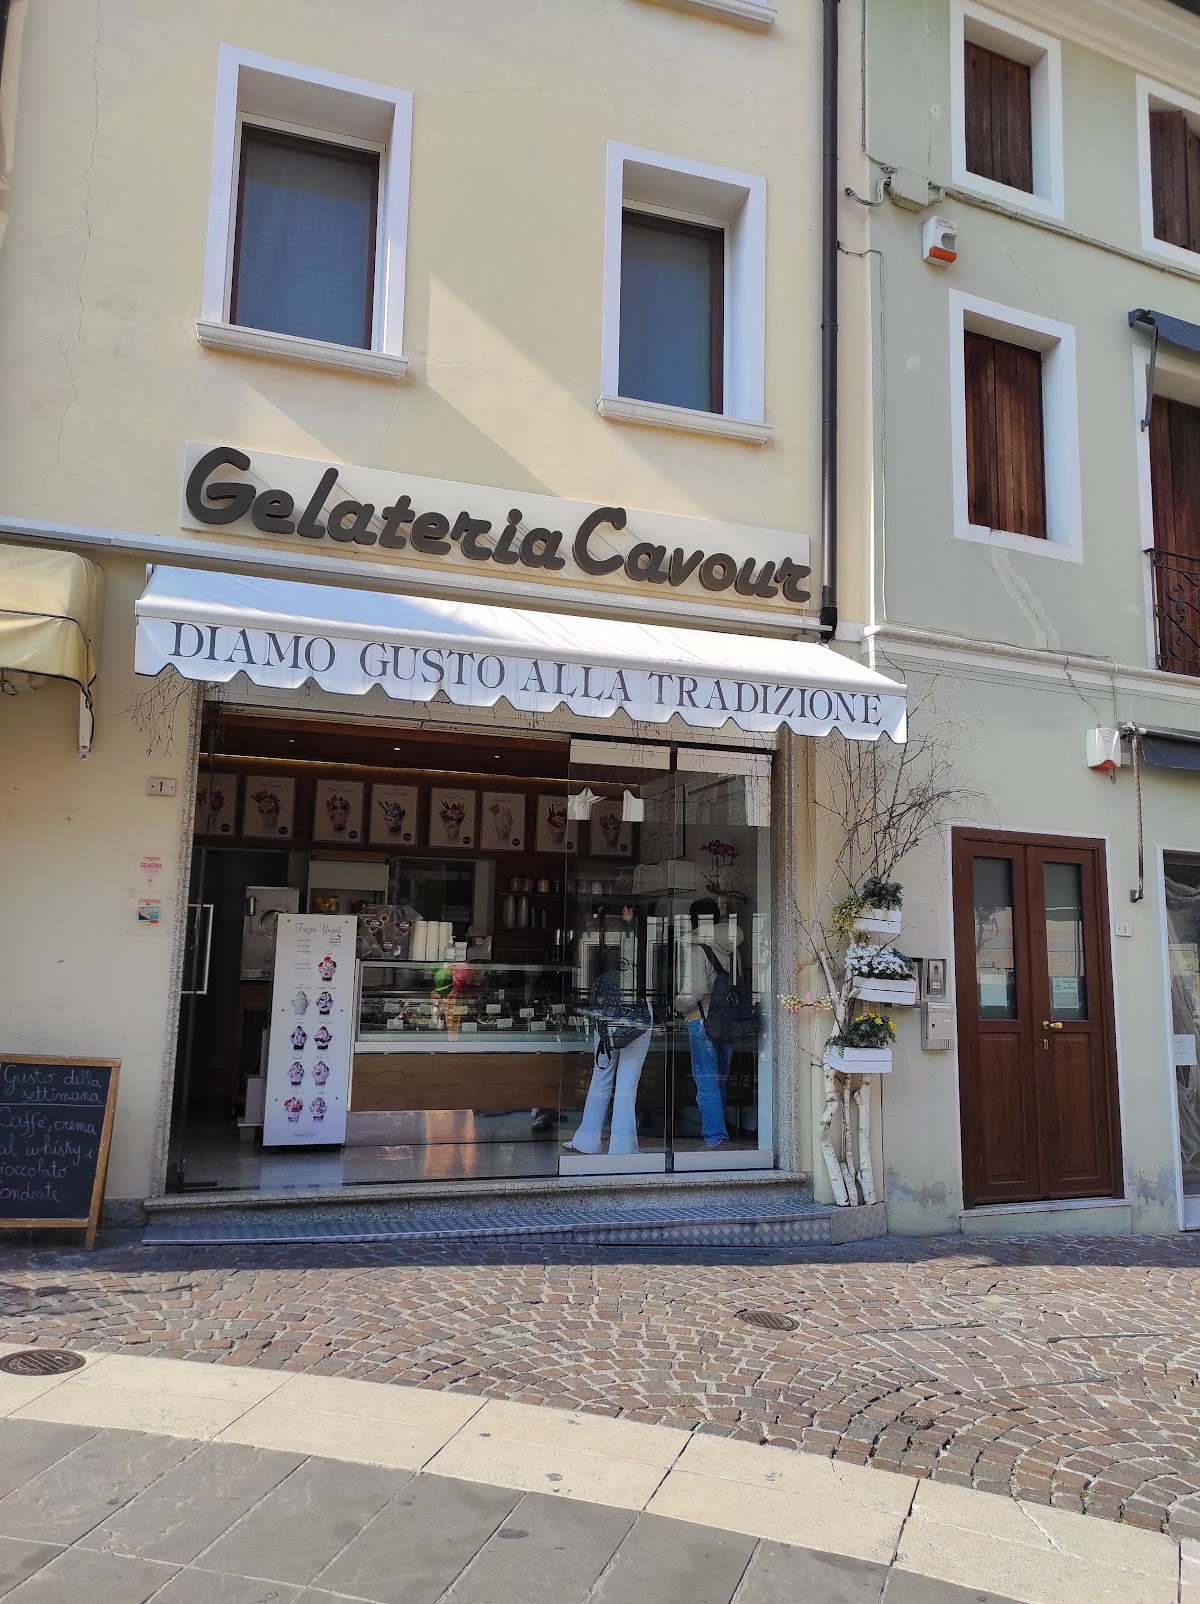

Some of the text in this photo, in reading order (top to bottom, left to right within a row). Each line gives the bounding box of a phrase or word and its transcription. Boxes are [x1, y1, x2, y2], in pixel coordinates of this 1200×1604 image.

[185, 446, 812, 603] Gelateria Cavour
[168, 621, 883, 727] DIAMO GUSTO ALLA TRADIZIONE
[4, 1064, 102, 1096] Gusto della
[22, 1086, 102, 1104] settimana
[54, 1119, 97, 1135] crema
[26, 1134, 81, 1166] whisky
[0, 1158, 69, 1178] ioccolato
[0, 1180, 61, 1203] ondente
